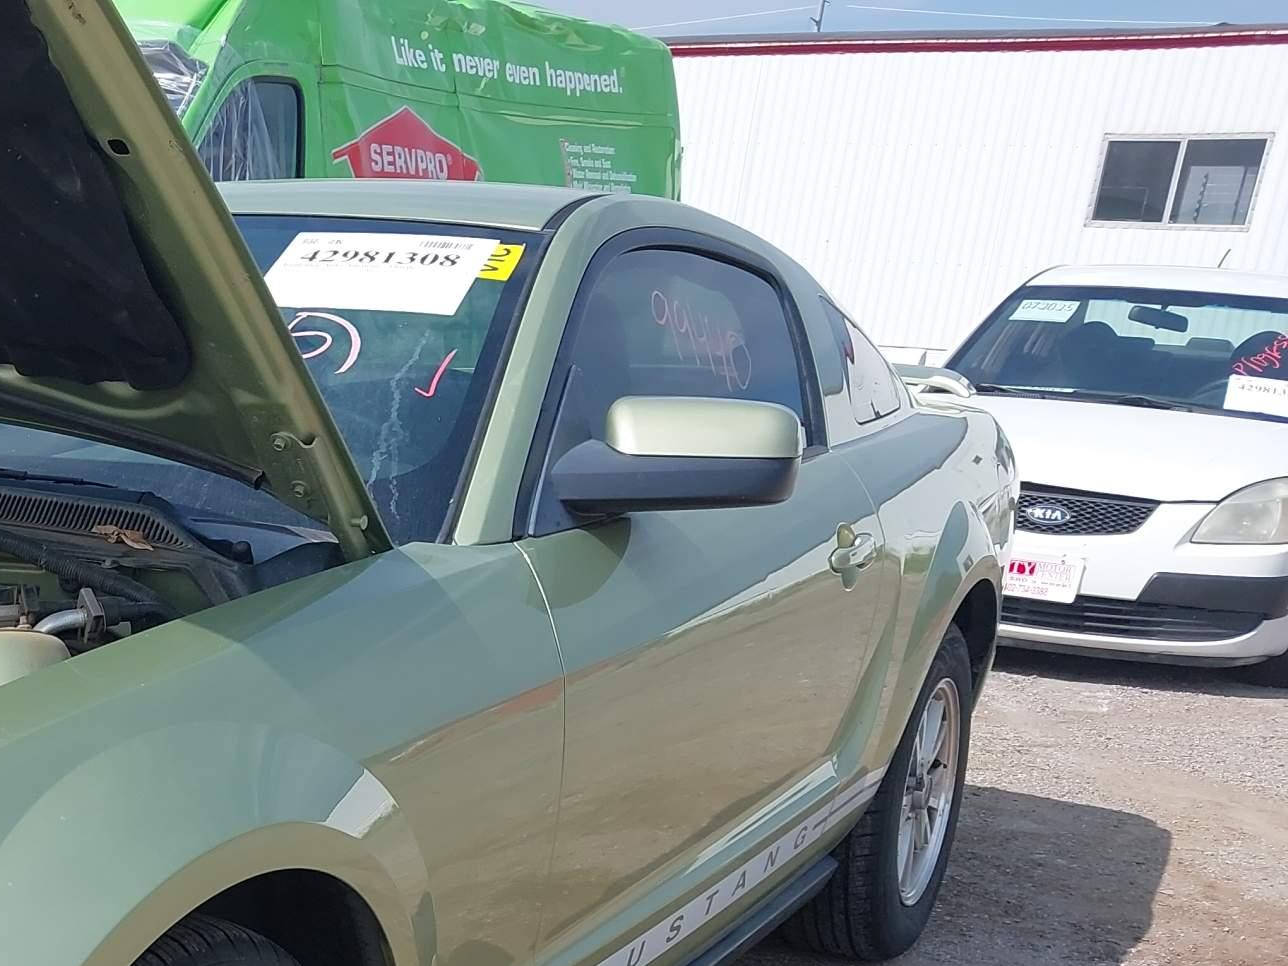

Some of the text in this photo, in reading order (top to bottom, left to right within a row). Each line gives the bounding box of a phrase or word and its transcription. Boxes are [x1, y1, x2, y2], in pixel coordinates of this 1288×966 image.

[391, 36, 623, 97] Like it never even happened.
[369, 143, 448, 180] SERVPRO
[300, 249, 461, 268] 42981308
[1032, 507, 1062, 520] KIA
